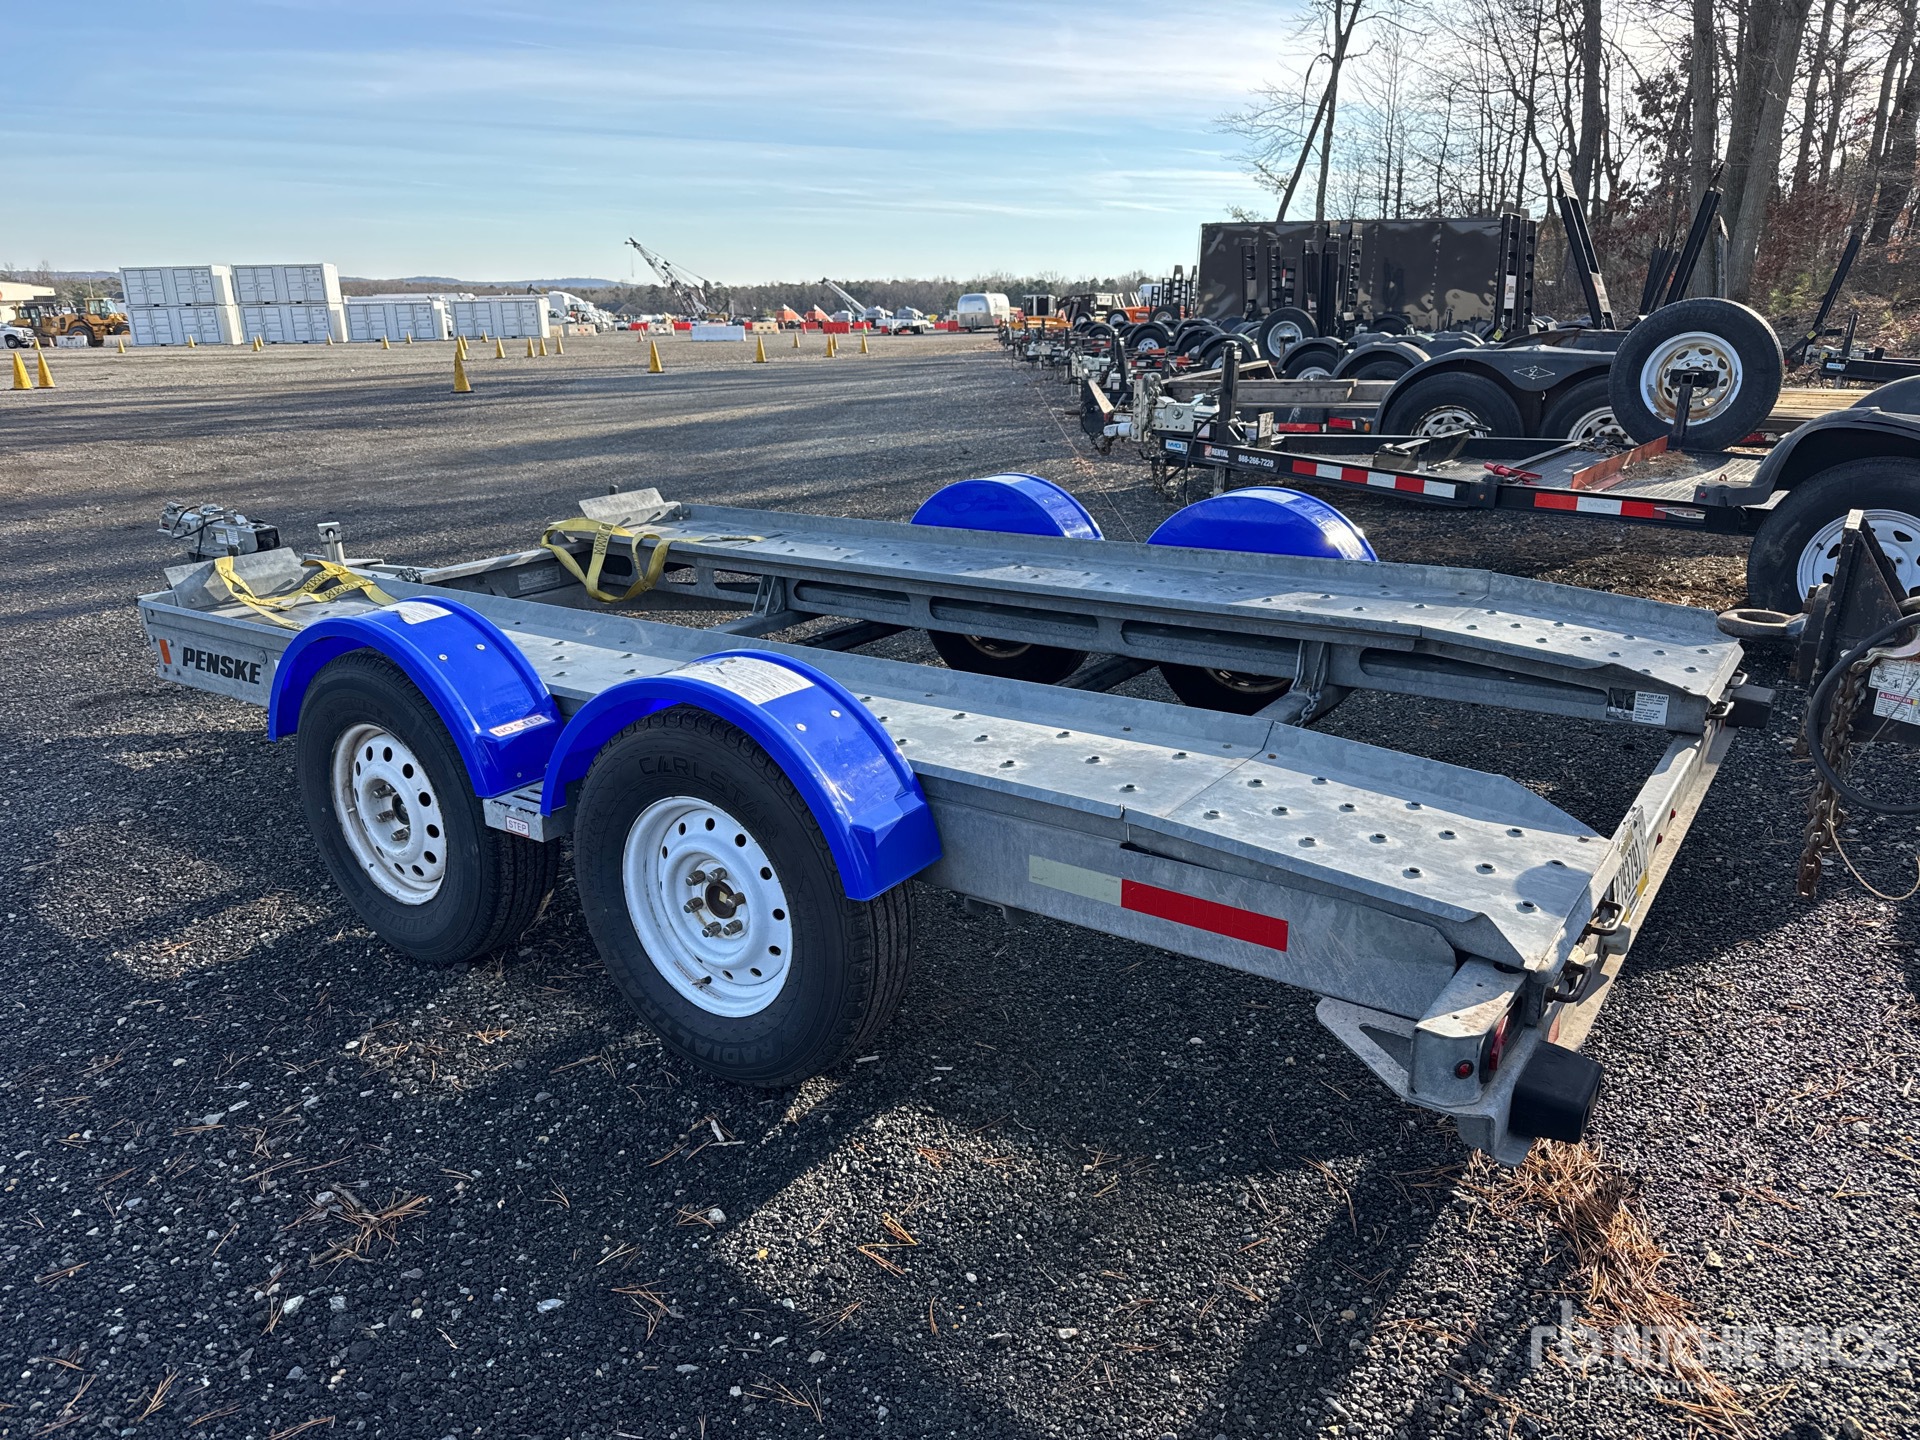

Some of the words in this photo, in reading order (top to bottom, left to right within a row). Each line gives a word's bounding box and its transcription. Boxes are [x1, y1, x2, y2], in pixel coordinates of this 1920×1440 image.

[1211, 447, 1230, 458] RENTAL
[182, 646, 262, 685] PENSKE
[1637, 693, 1669, 701] IMPORTANT
[1886, 694, 1912, 704] DANGER
[494, 725, 514, 735] NO
[513, 715, 543, 729] STEP
[638, 755, 779, 842] CARLSTAR
[508, 819, 527, 832] STEP
